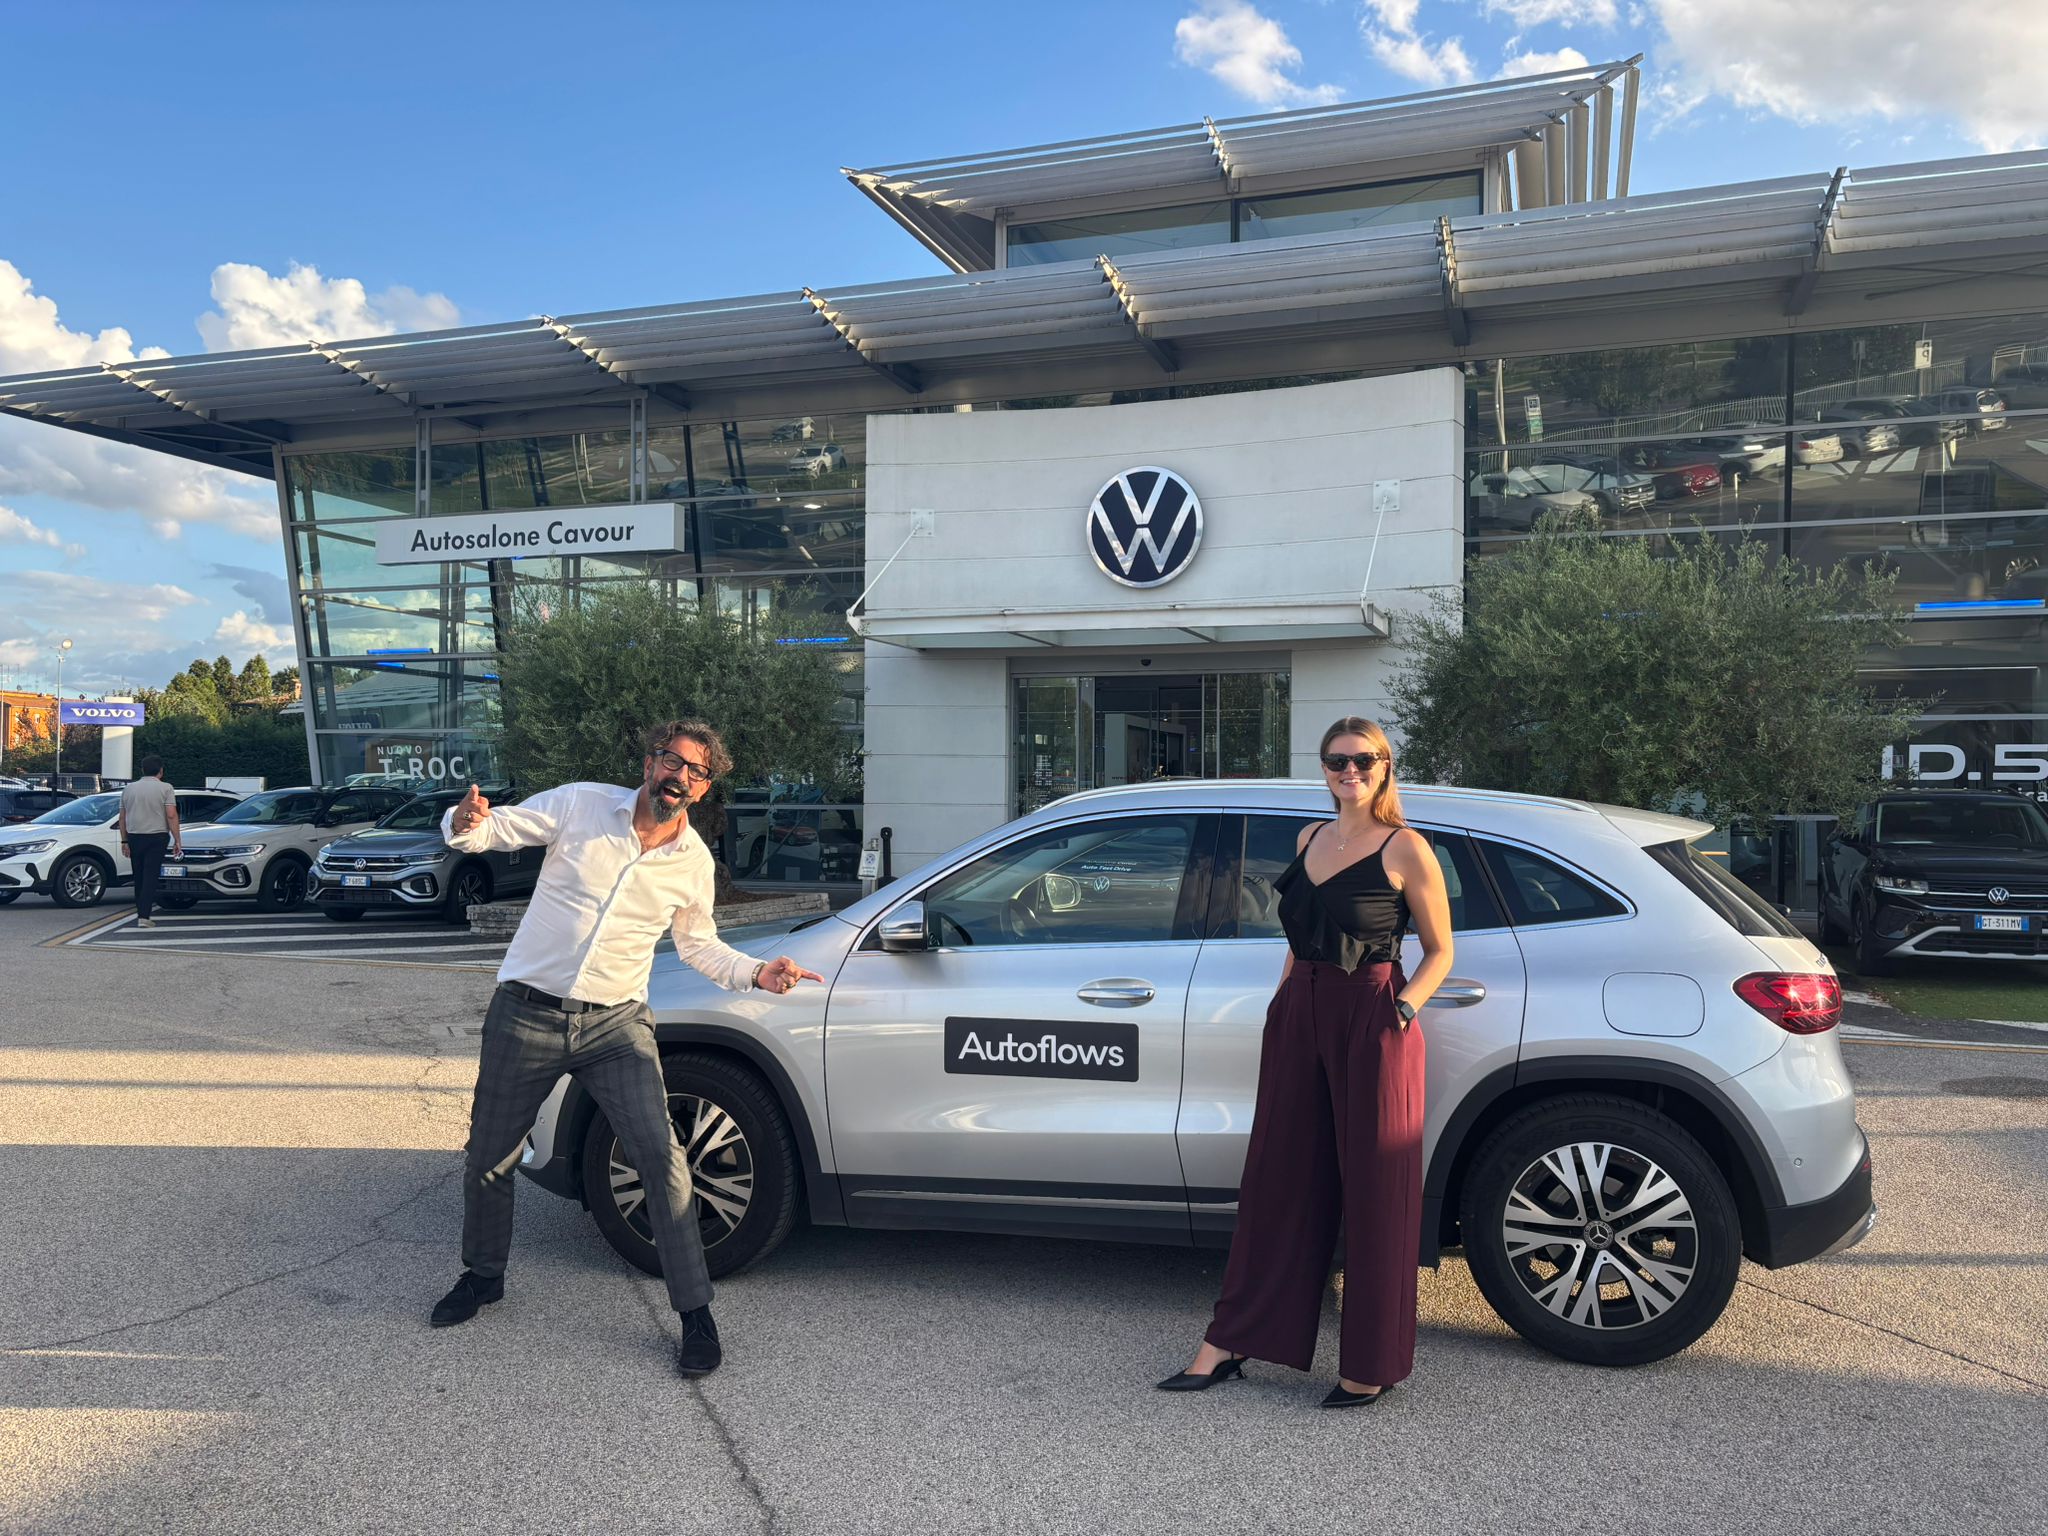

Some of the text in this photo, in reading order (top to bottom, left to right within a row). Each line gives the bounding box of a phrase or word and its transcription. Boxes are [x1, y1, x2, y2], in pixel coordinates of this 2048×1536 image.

[410, 520, 635, 552] Autosalone Cavour
[70, 707, 136, 718] VOLVO
[377, 745, 423, 755] NUOVO
[378, 756, 466, 781] T-ROC
[958, 1031, 1125, 1067] Autoflows
